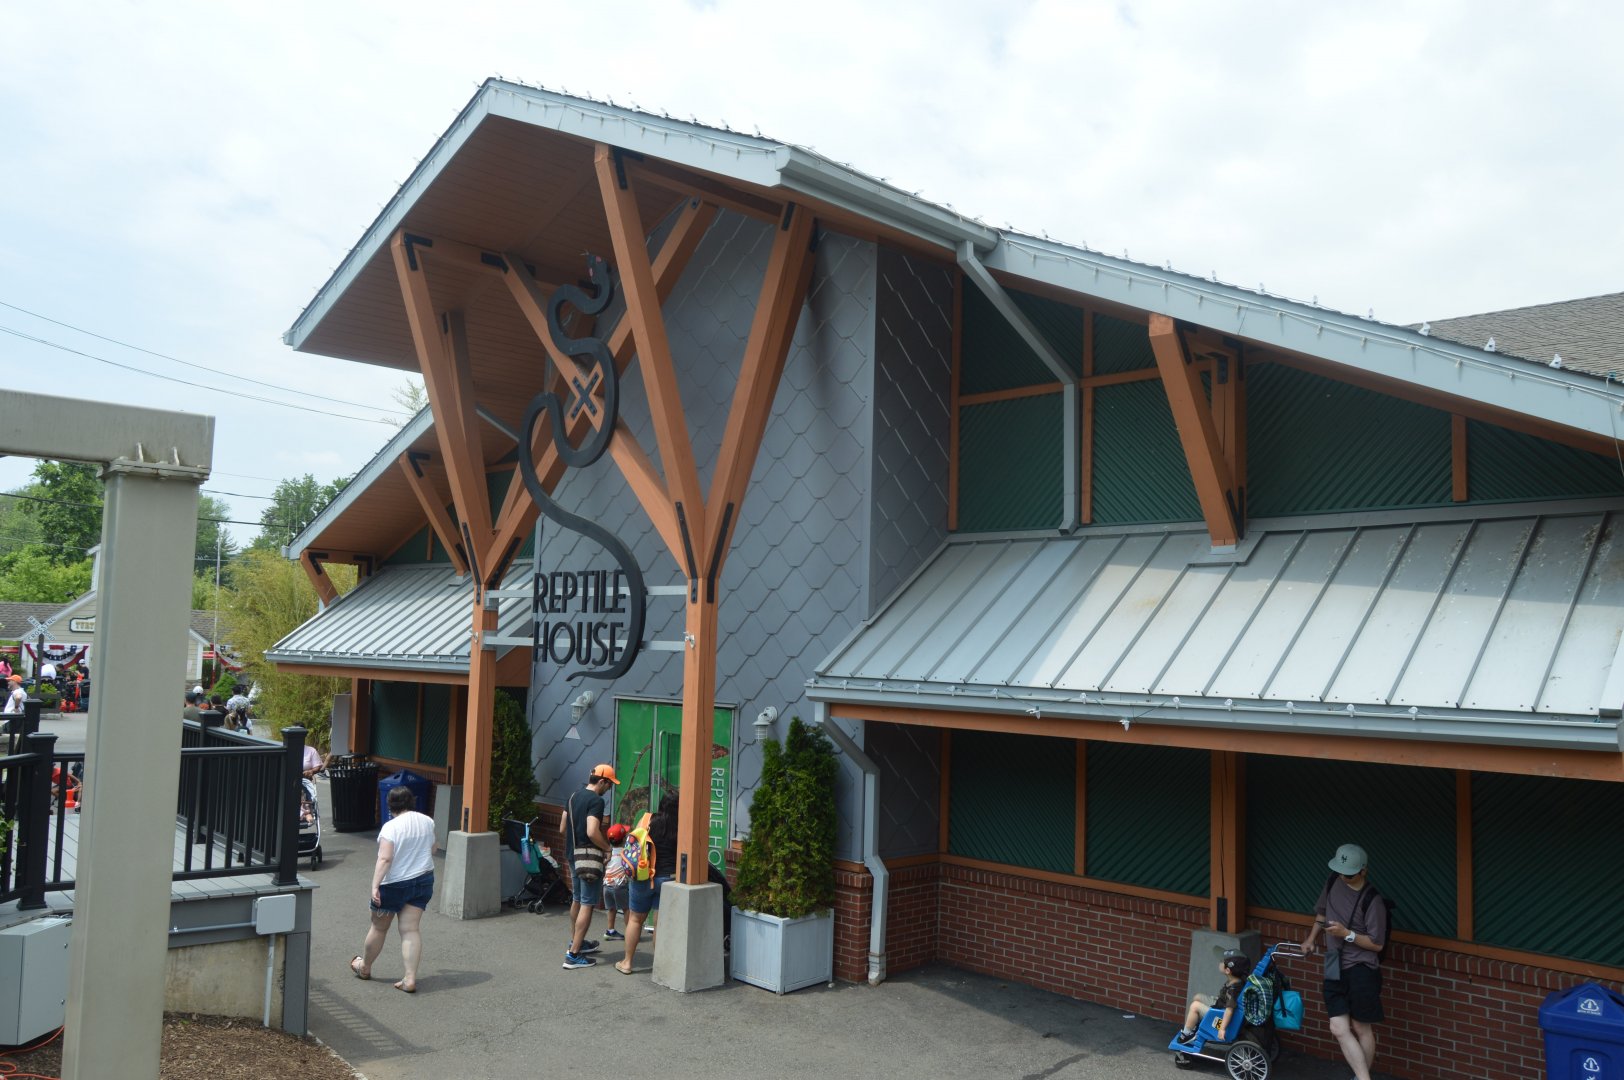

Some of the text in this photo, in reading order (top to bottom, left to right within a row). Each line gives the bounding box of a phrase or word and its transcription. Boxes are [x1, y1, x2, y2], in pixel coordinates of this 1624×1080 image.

[532, 569, 627, 614] REPTILE
[532, 621, 625, 667] HOUSE
[708, 767, 725, 870] REPTILE HO
